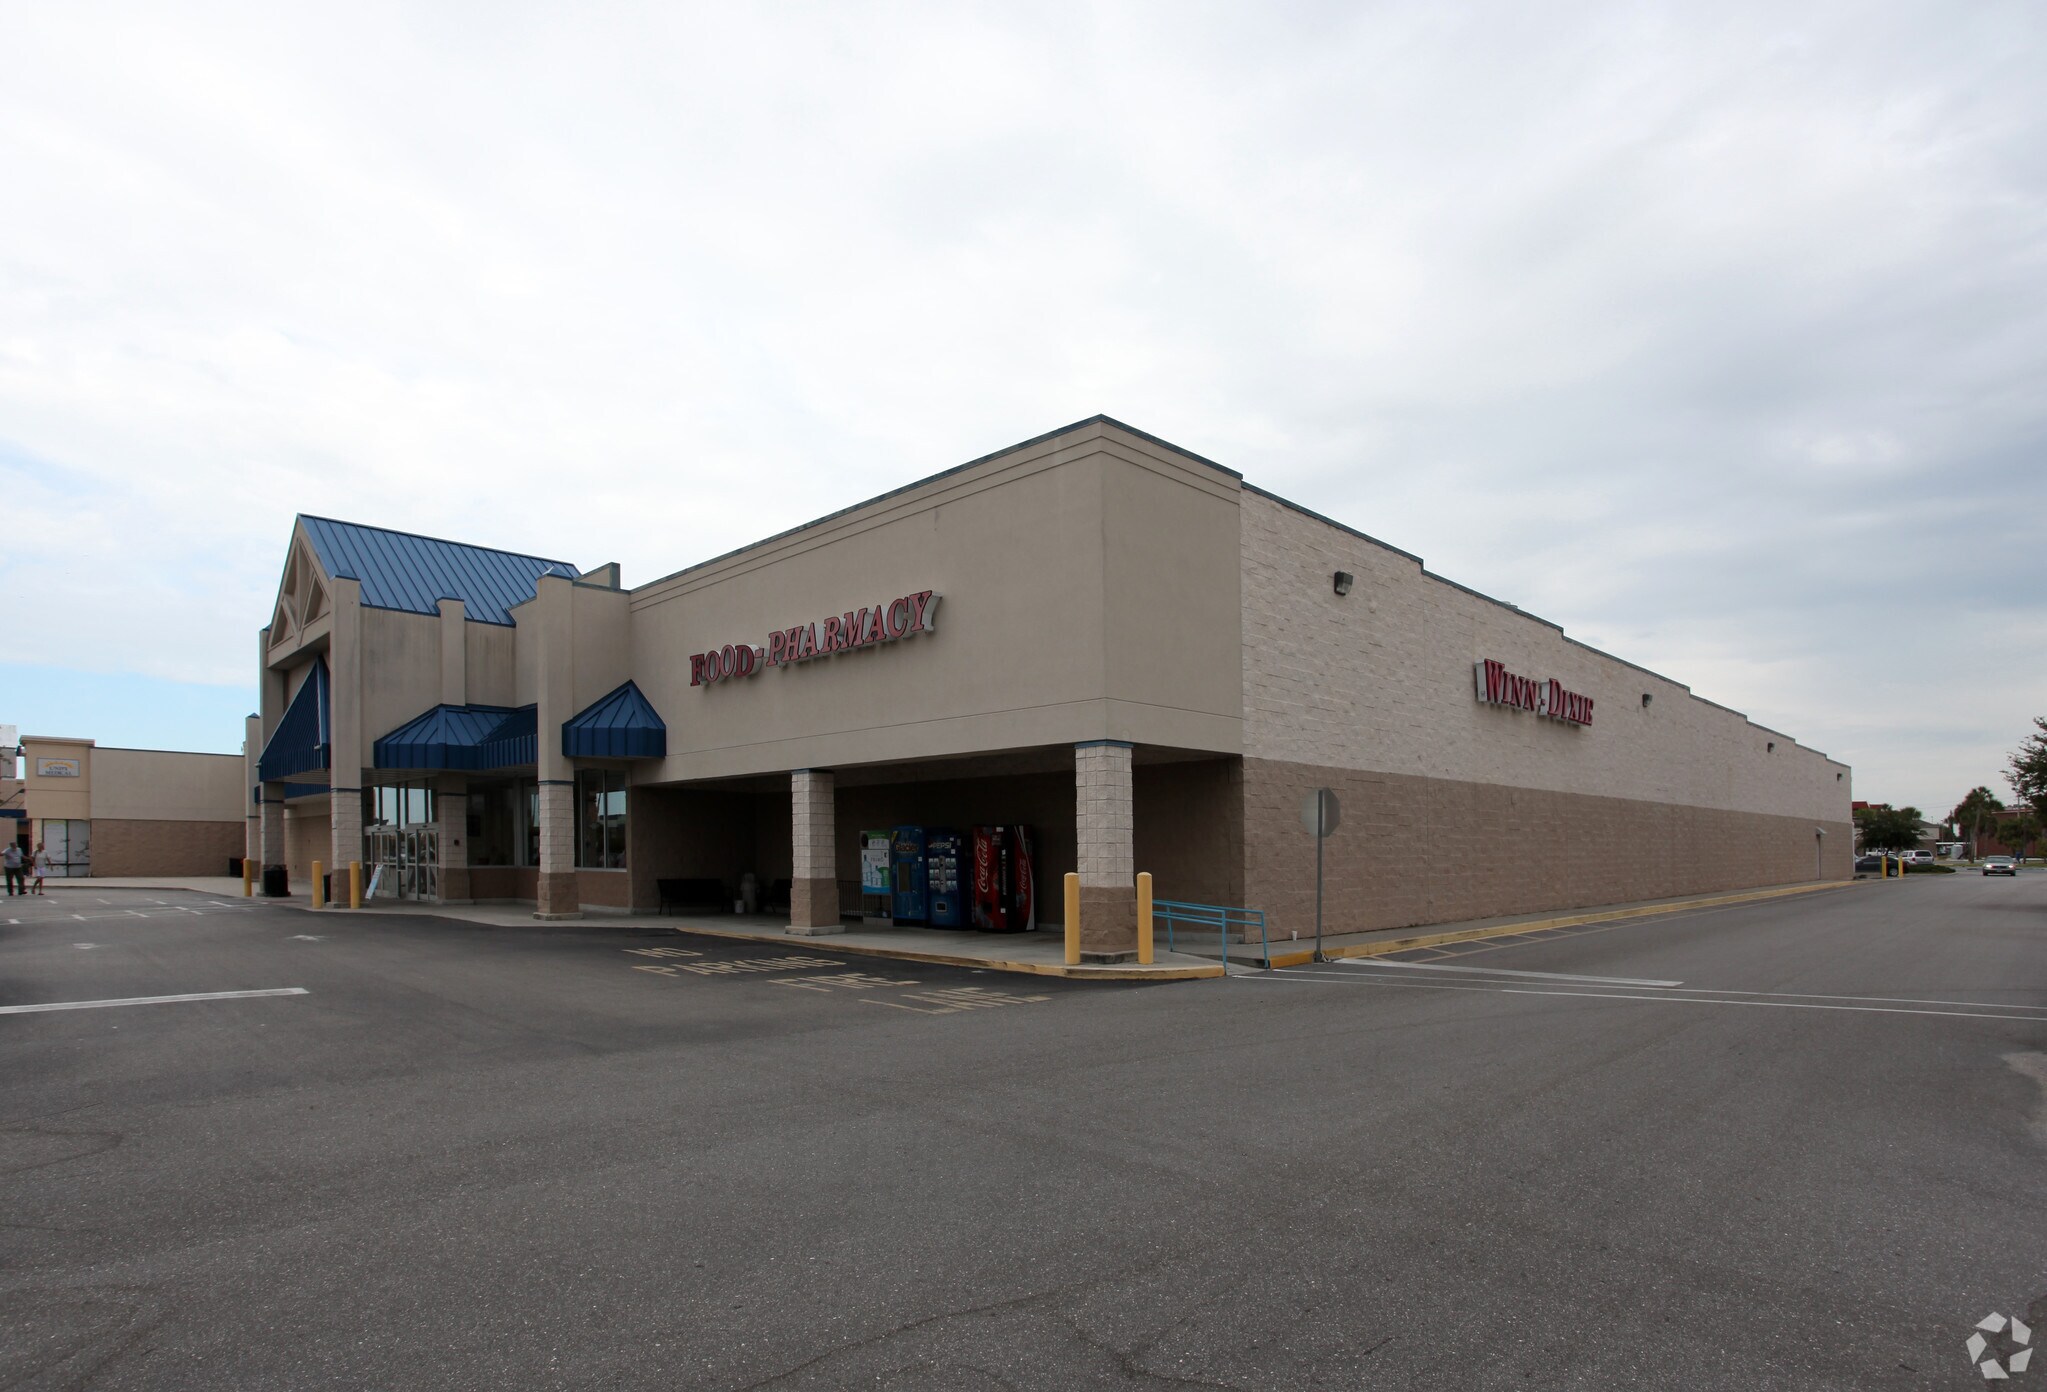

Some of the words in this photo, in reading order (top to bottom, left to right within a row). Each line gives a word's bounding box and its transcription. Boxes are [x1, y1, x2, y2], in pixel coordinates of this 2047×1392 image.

[932, 841, 952, 849] PEPSI
[622, 946, 704, 958] NO
[632, 956, 848, 977] PARKING
[766, 972, 921, 992] FIRE
[858, 986, 1053, 1015] LANE
